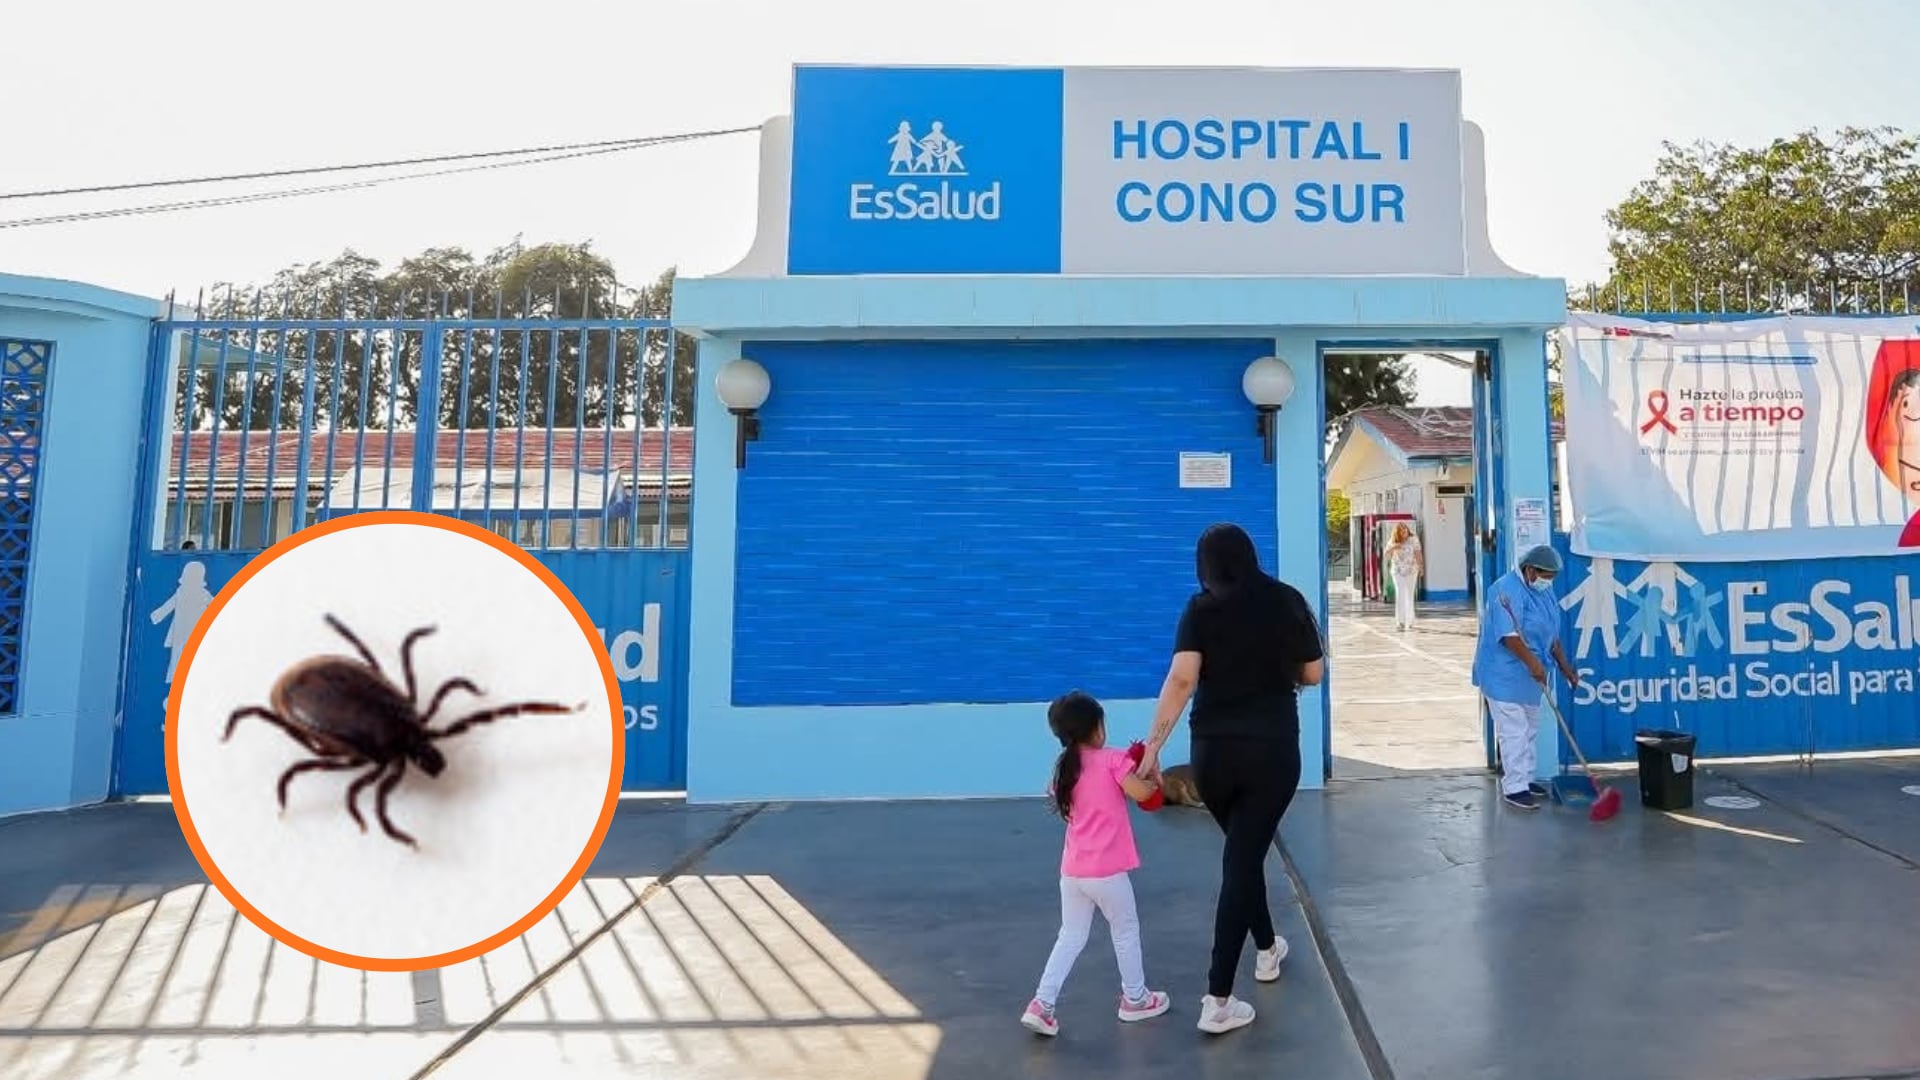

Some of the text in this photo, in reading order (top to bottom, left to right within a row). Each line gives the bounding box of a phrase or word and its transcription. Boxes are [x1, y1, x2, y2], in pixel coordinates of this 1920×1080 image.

[1113, 119, 1410, 160] HOSPITAL I
[850, 180, 1001, 220] EsSalud
[1116, 181, 1405, 223] CONO SUR
[1679, 402, 1805, 427] a tiempo
[1680, 388, 1804, 404] Hazte la prueba
[1728, 575, 1920, 654] EsSal
[1574, 663, 1738, 713] Seguridad
[1745, 660, 1840, 697] Social
[1849, 667, 1914, 704] para
